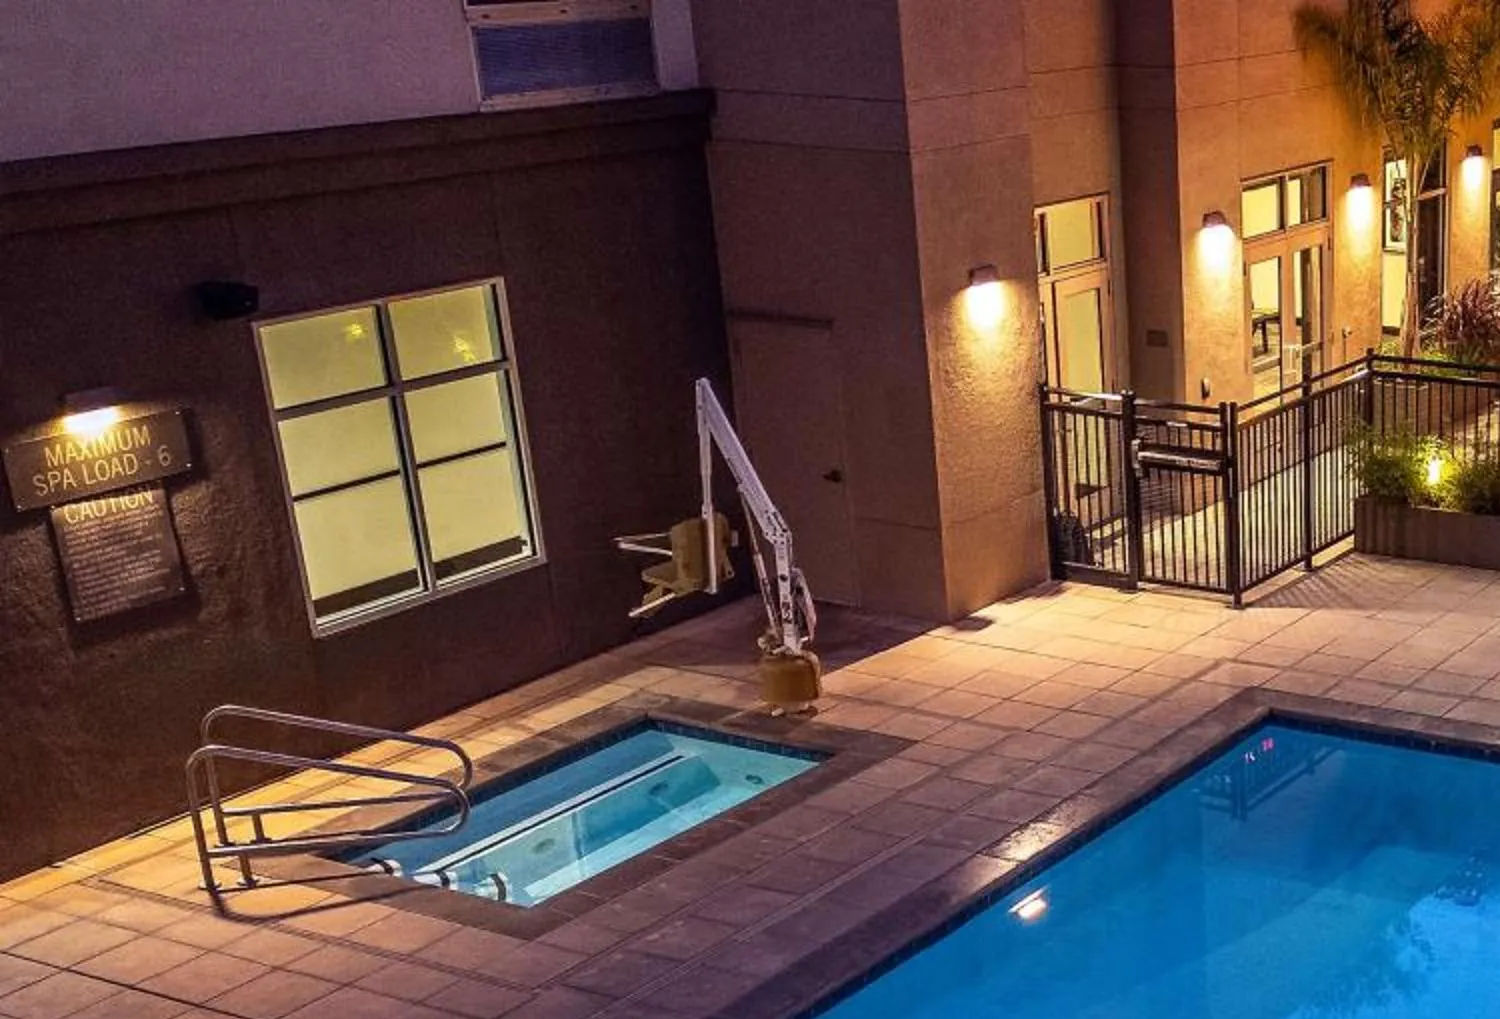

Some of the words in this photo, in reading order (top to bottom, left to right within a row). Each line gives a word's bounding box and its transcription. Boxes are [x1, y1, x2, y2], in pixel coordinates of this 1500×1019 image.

[44, 425, 151, 468] MAXIMUM
[33, 470, 77, 497] SPA
[84, 453, 139, 485] LOAD
[157, 444, 171, 467] 6
[63, 488, 155, 524] CAUTION
